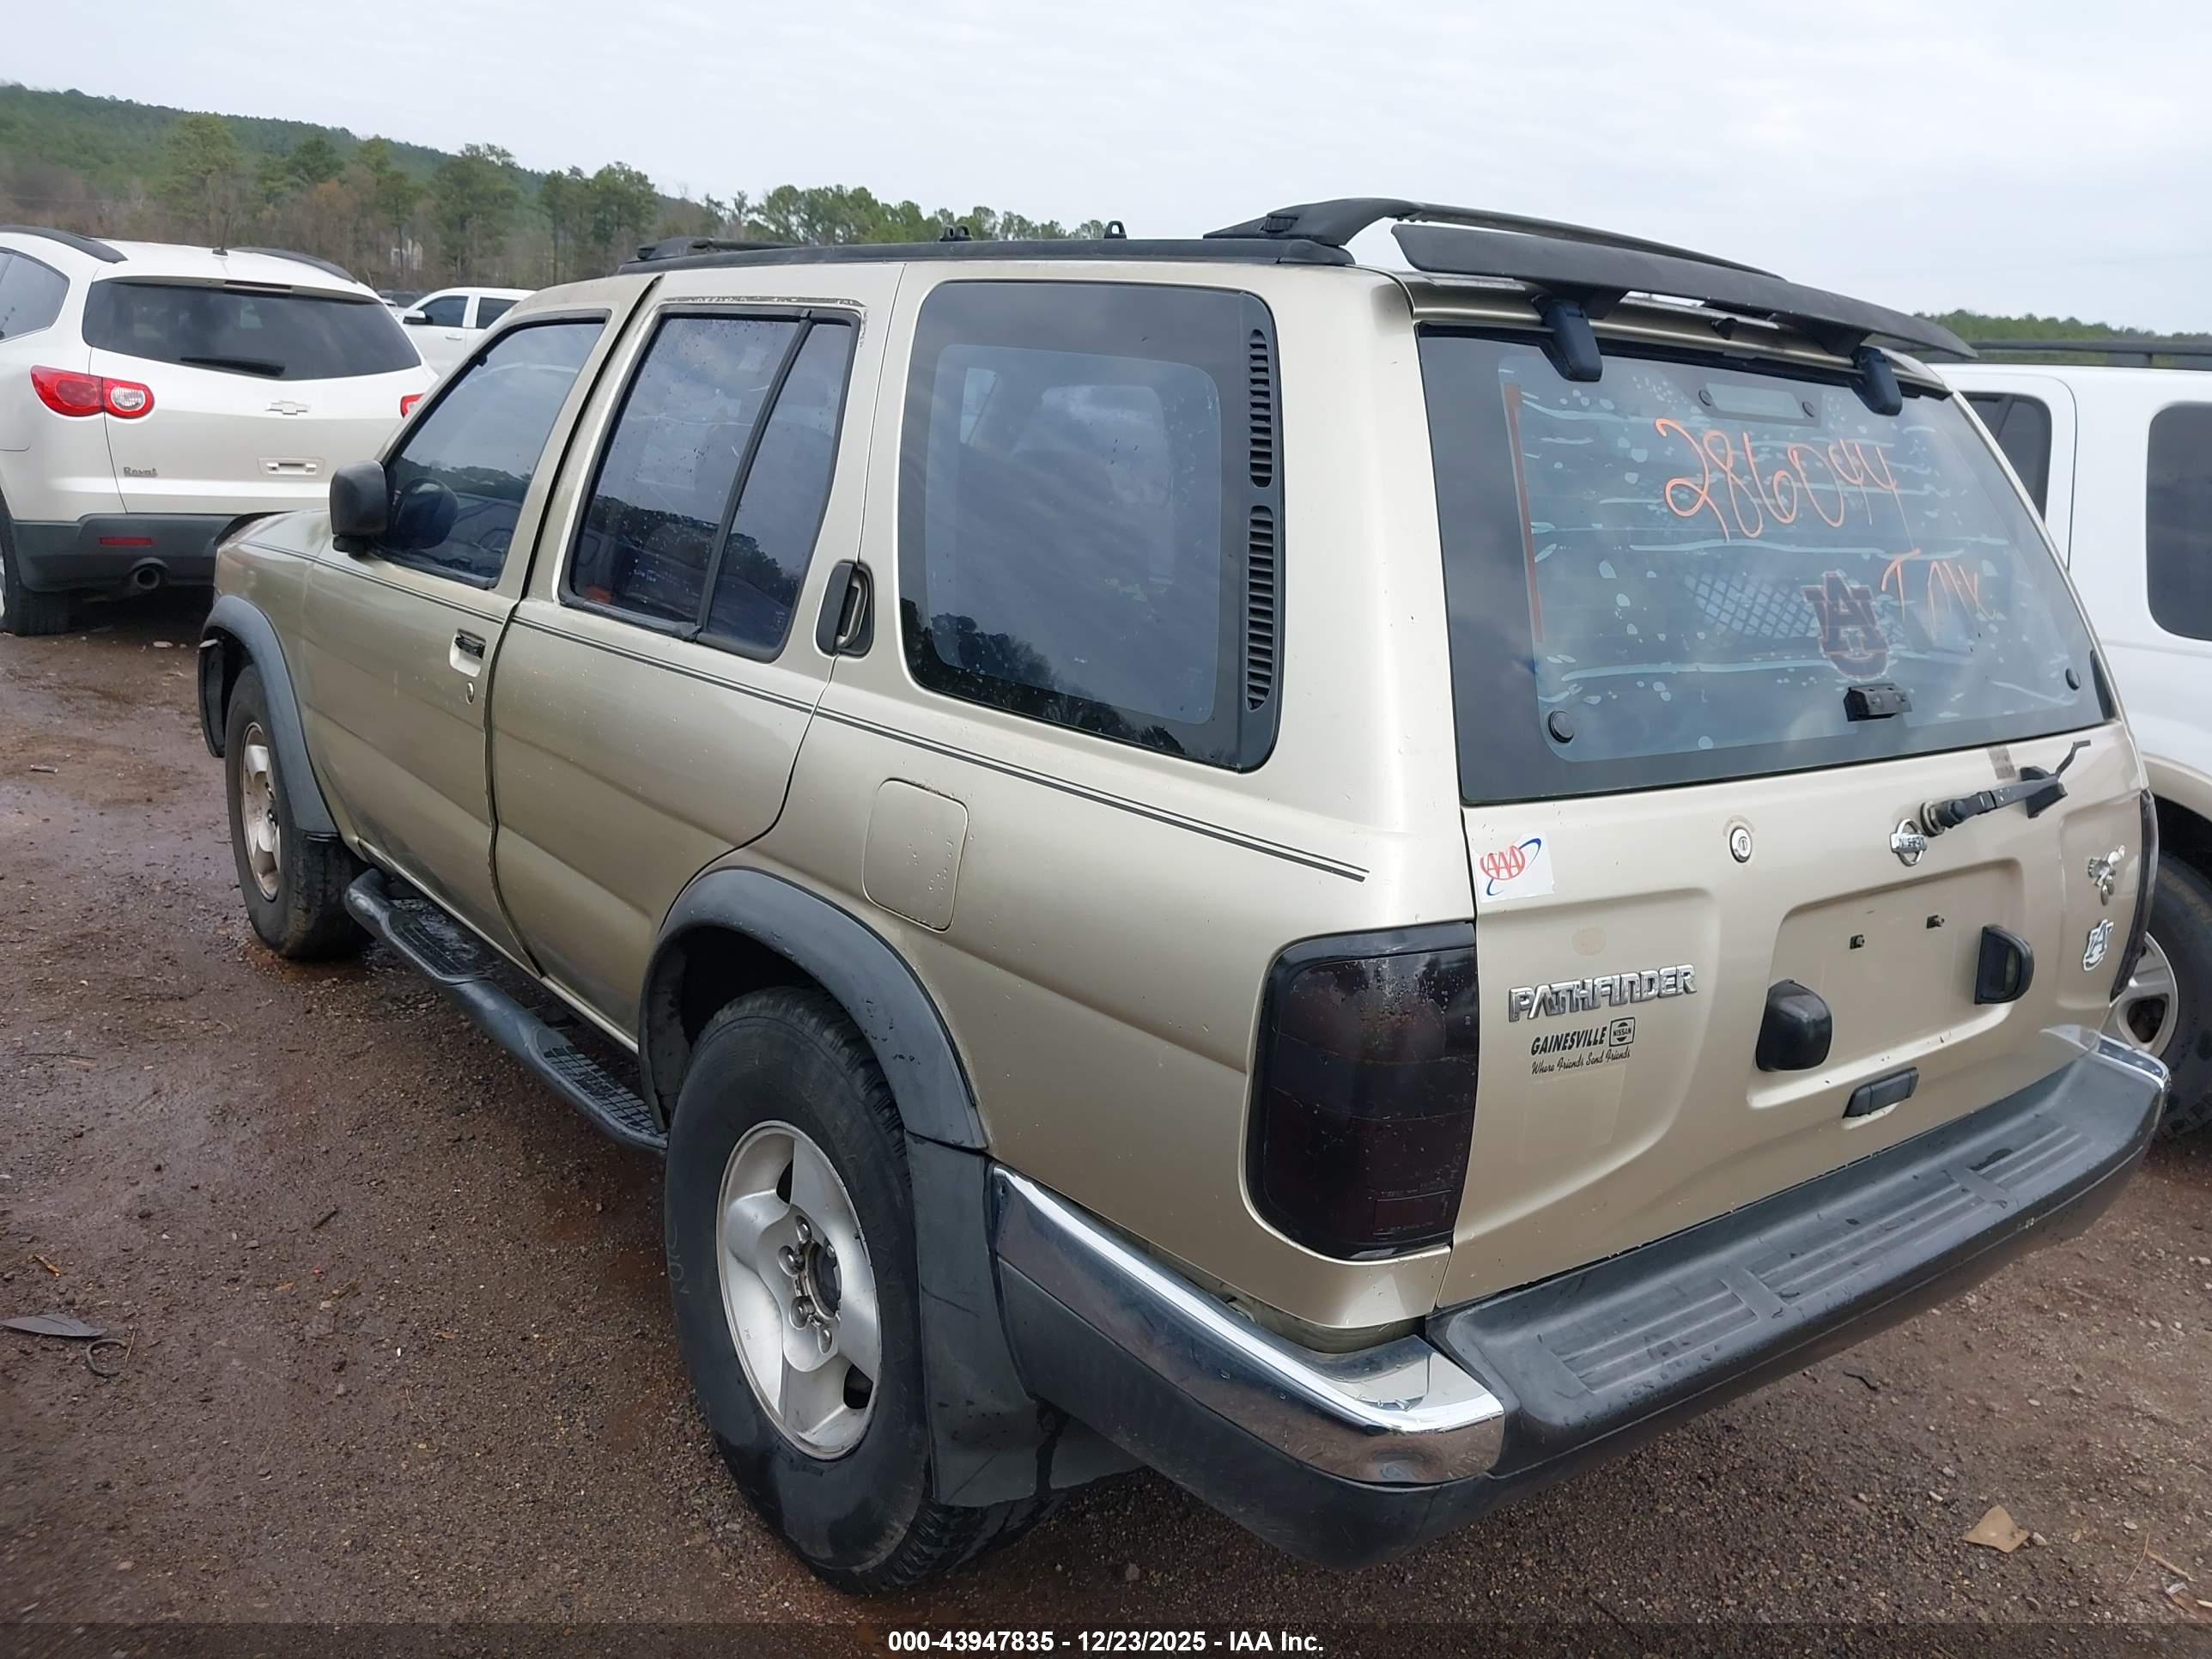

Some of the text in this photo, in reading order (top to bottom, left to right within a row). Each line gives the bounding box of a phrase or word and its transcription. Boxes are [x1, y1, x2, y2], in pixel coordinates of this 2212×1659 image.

[1655, 418, 1911, 546] 286044
[1482, 846, 1524, 880] AAA
[1508, 963, 1698, 1022] PATHFINDER
[1531, 1026, 1632, 1056] GAINESVILLE NISSAN
[1557, 1054, 1584, 1072] Friends
[1585, 1050, 1604, 1066] Send
[1605, 1046, 1631, 1063] Friends
